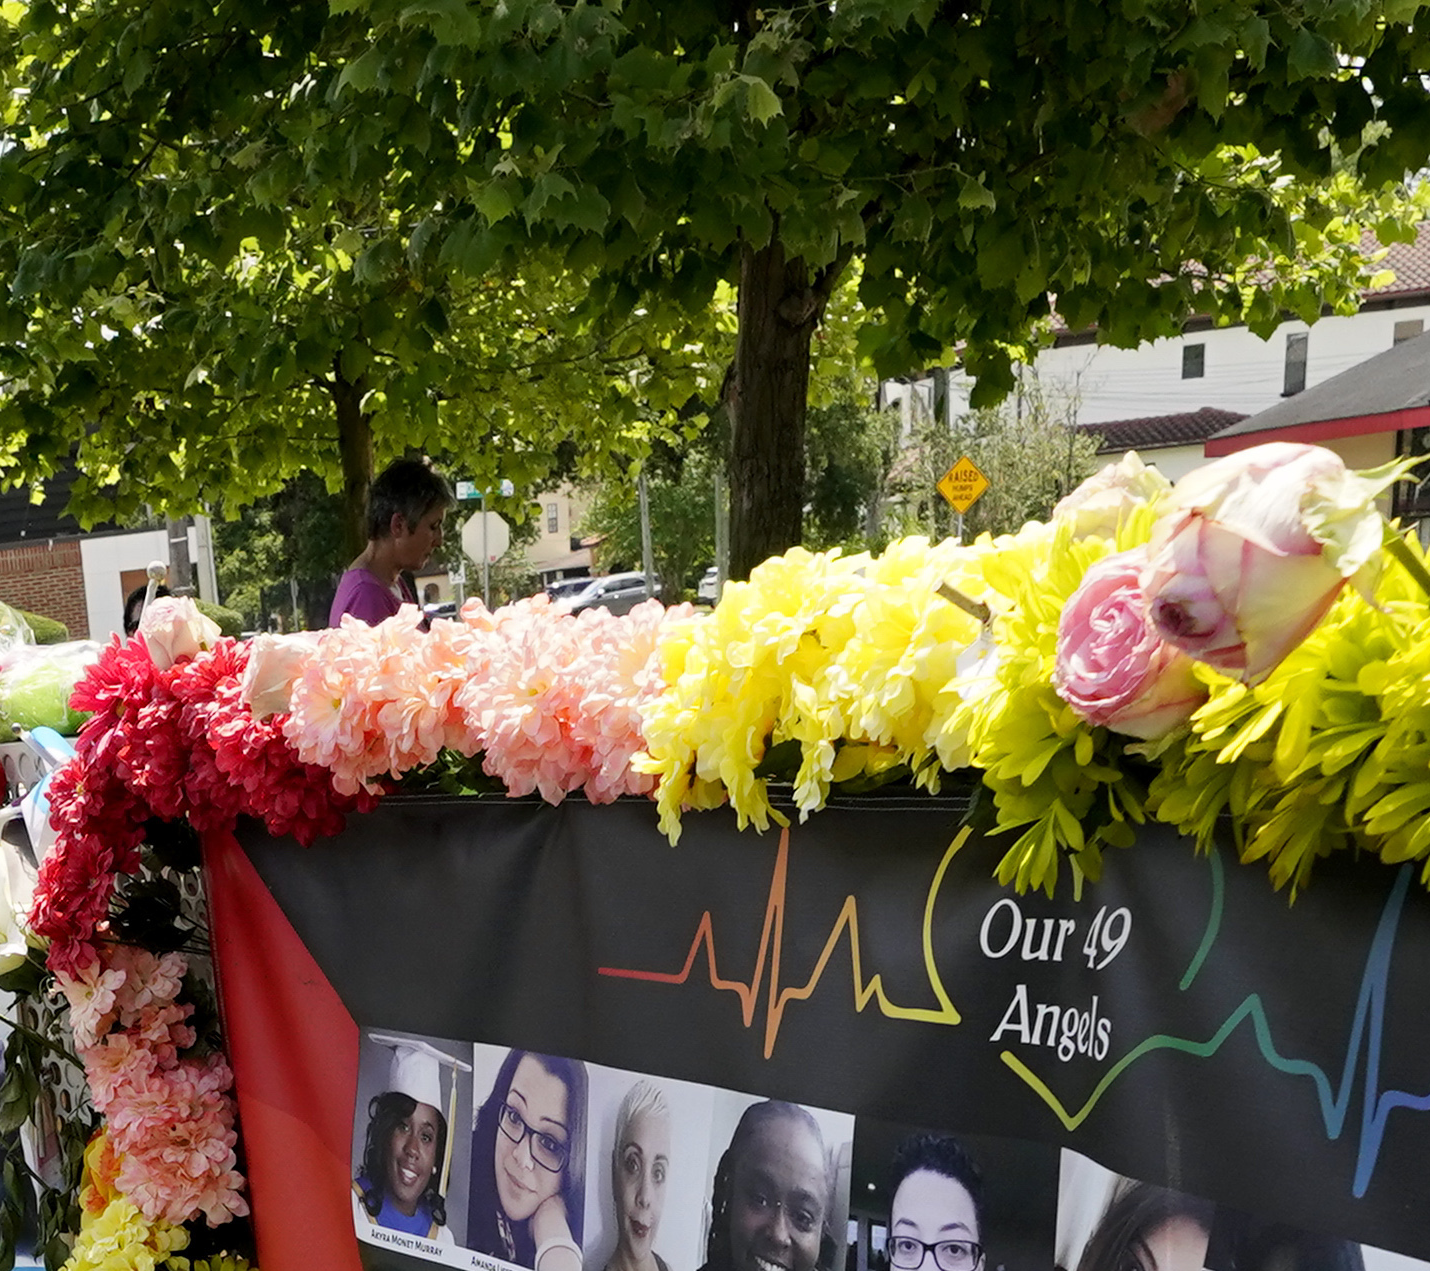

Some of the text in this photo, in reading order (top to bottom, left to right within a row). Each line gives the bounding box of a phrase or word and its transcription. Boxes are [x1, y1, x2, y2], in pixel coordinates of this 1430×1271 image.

[948, 470, 979, 483] RAISED
[978, 898, 1133, 972] Our 49
[989, 983, 1113, 1063] Angels
[371, 1229, 442, 1256] AKYRA MONET MURRAY
[471, 1256, 496, 1271] AMANDA
